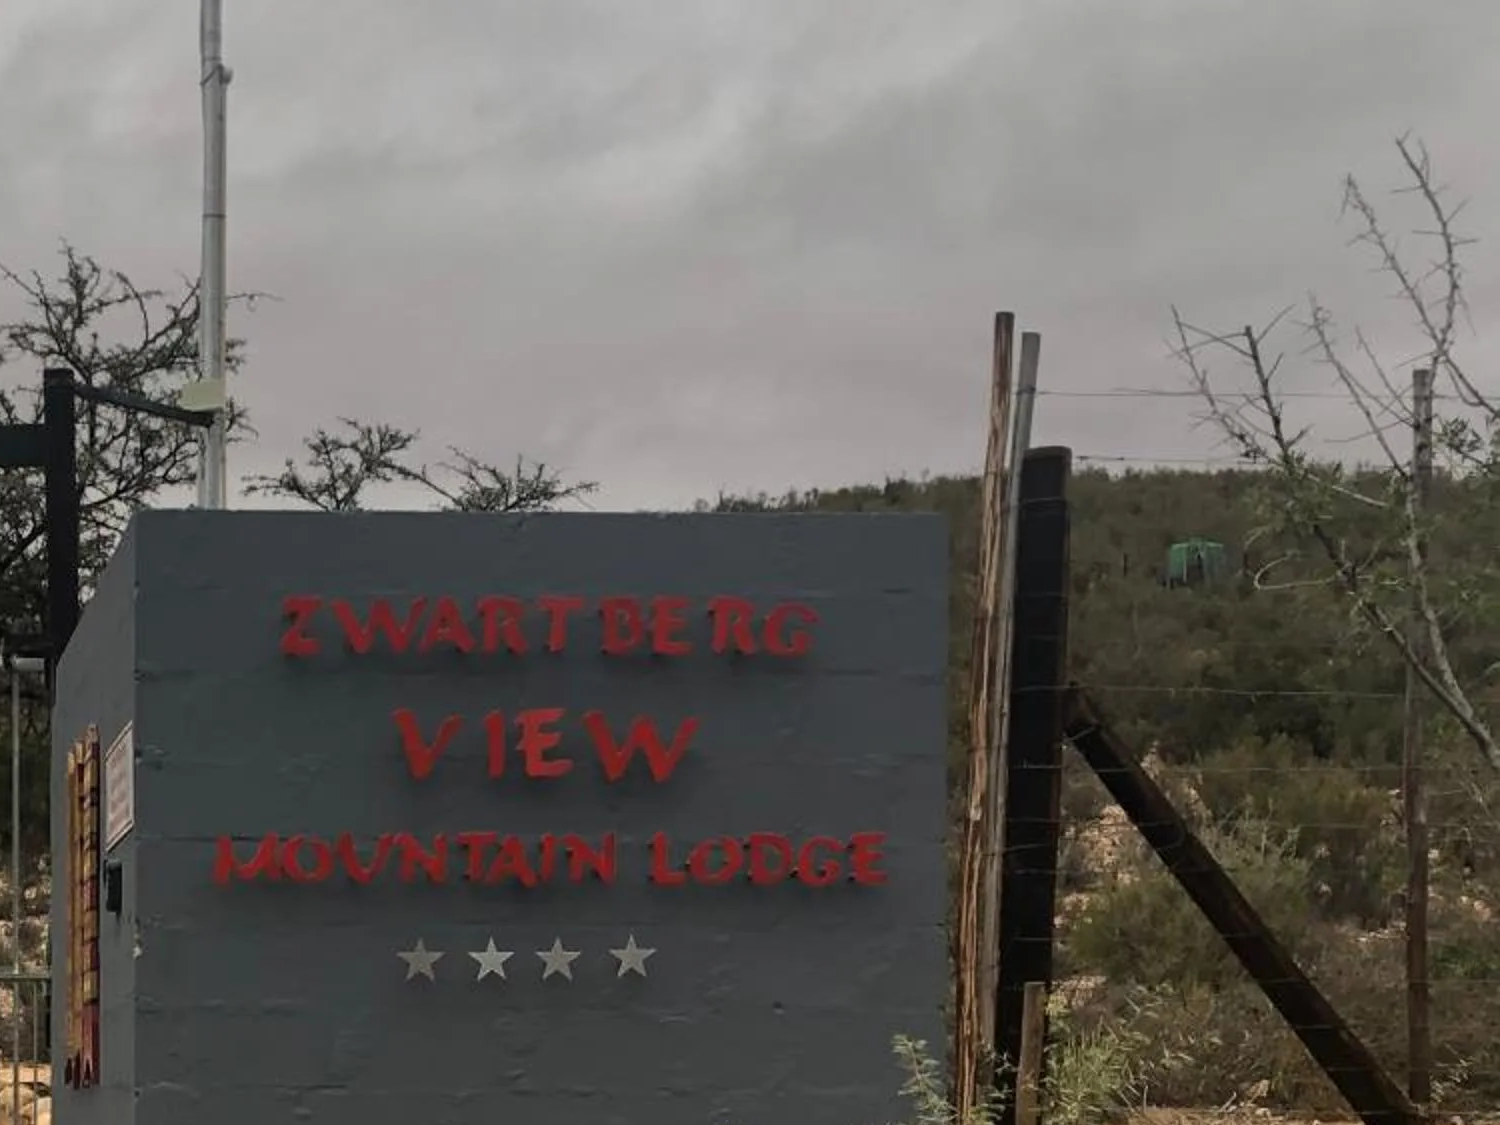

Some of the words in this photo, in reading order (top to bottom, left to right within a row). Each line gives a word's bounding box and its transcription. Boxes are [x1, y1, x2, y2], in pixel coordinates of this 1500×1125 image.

[281, 596, 815, 655] ZWARTBERG
[394, 706, 698, 781] VIEW
[650, 830, 884, 886] LODGE
